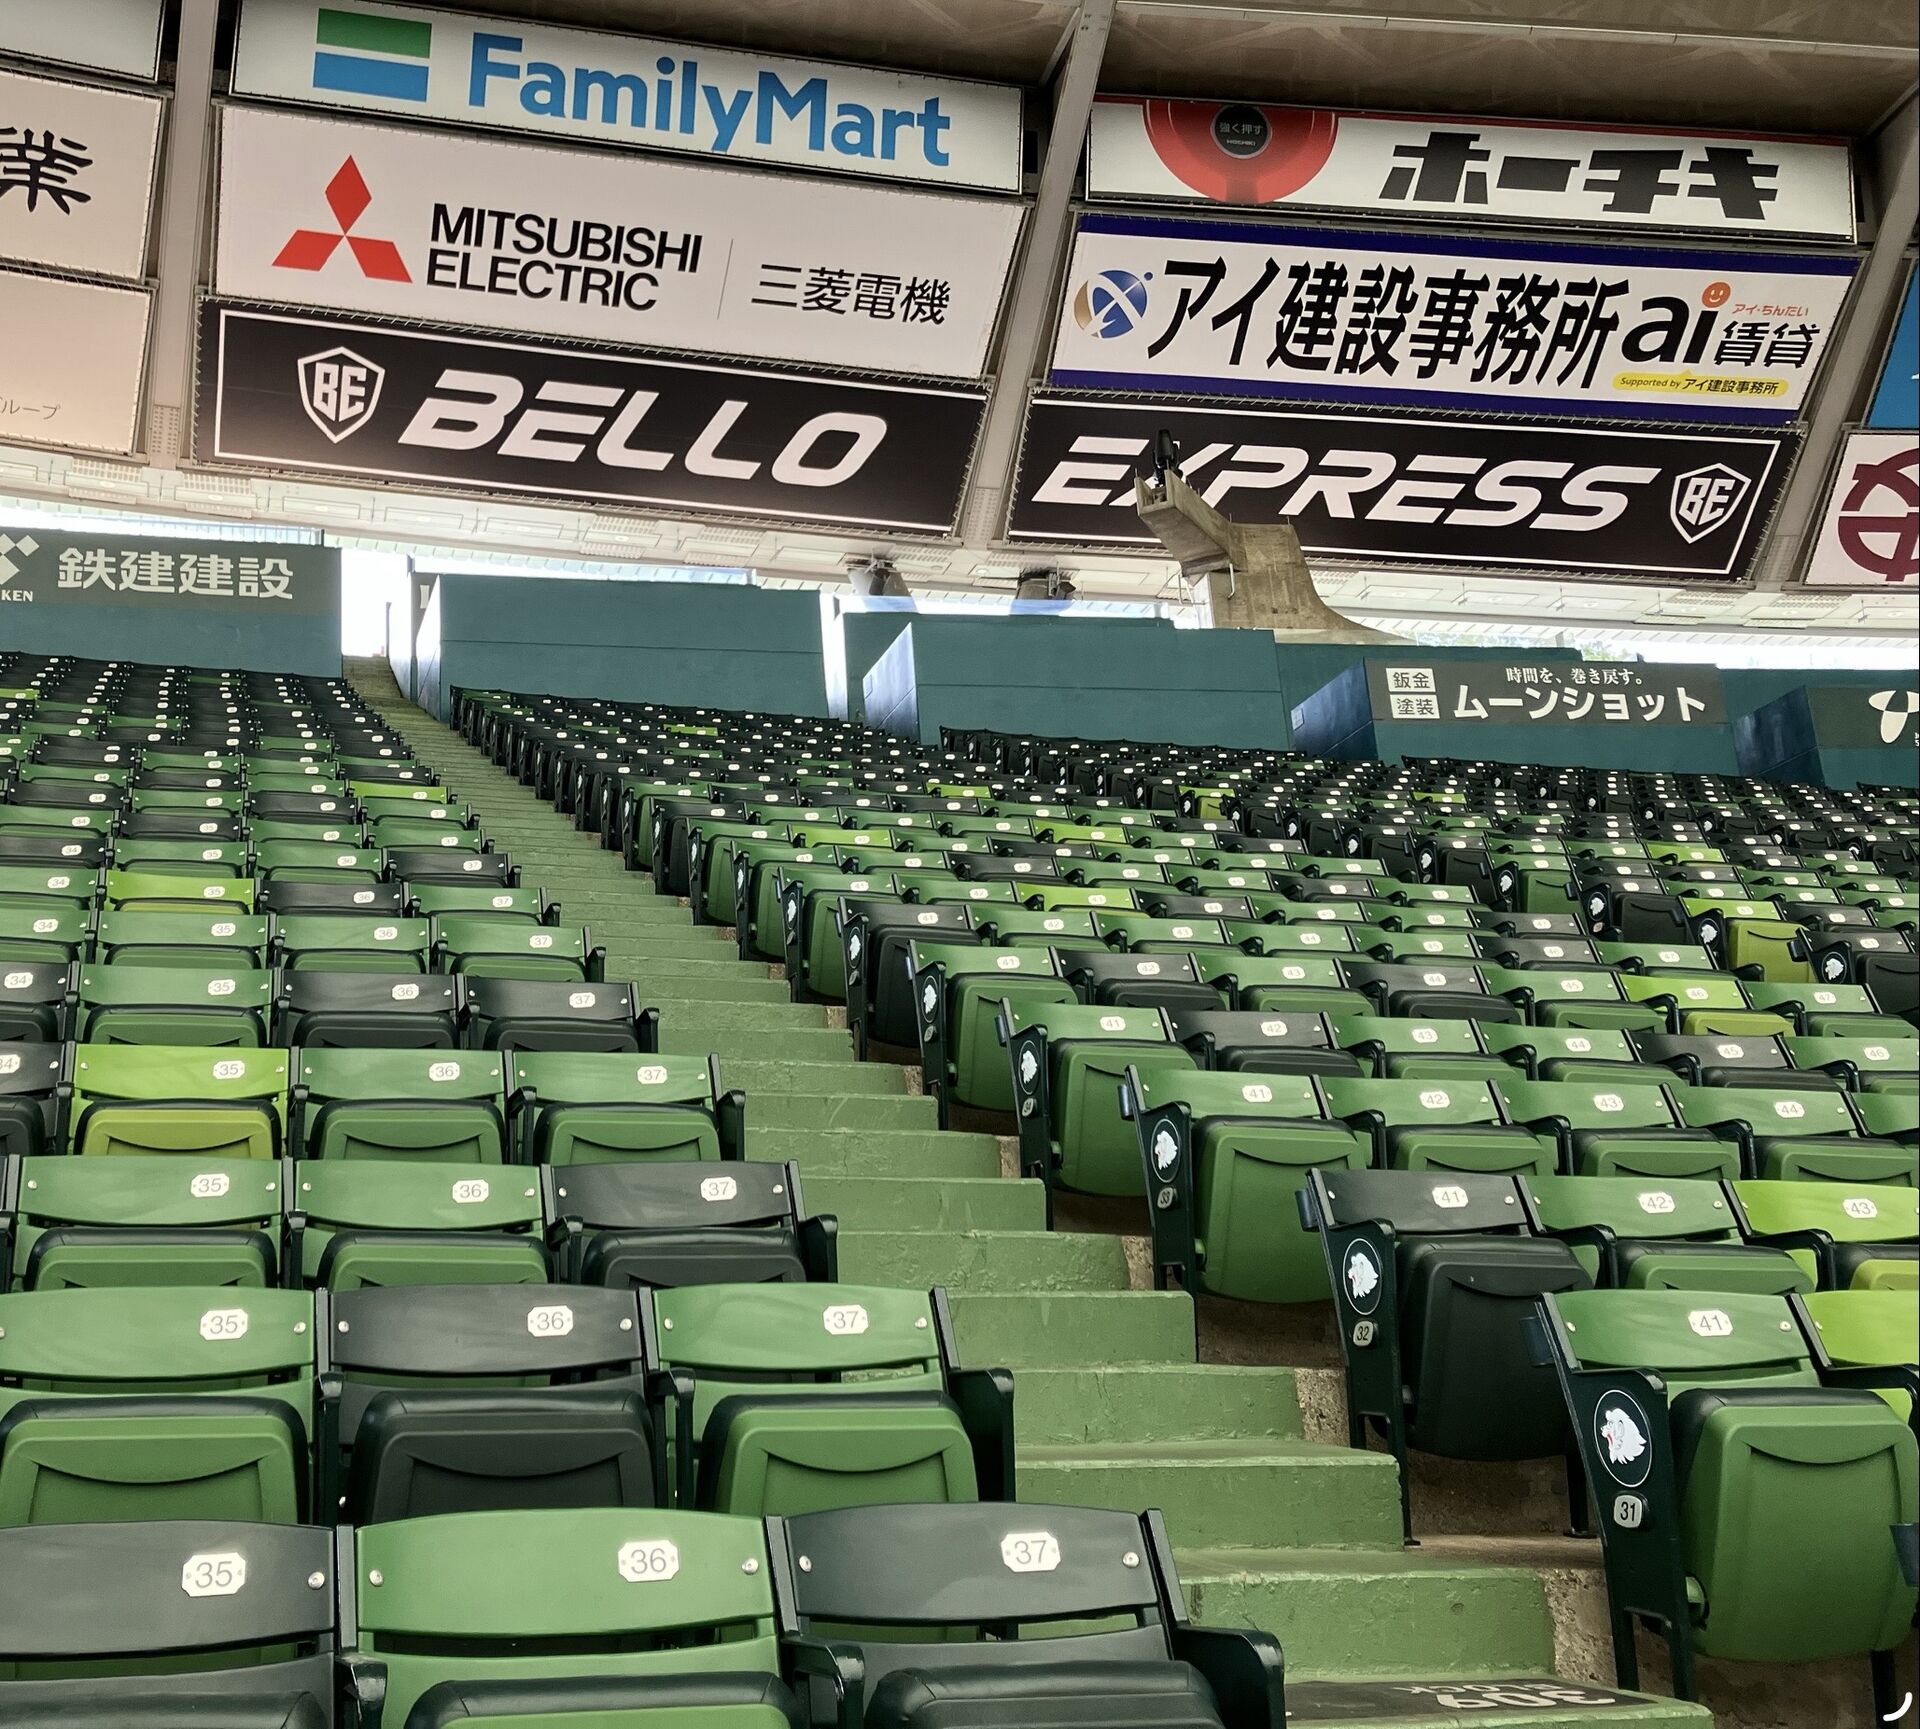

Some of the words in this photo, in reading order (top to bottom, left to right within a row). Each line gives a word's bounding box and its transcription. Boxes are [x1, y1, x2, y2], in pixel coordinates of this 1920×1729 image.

[468, 32, 951, 167] FamilyMart
[1219, 122, 1263, 136] 強く押す
[1379, 131, 1779, 221] ホーチキ
[430, 203, 703, 273] MITSUBISHI
[426, 248, 660, 312] ELECTRIC
[751, 262, 951, 325] 三菱電機
[1732, 303, 1809, 317] アイ・ちんたい
[1147, 256, 1629, 390] アイ建設事務所
[1714, 320, 1821, 368] 賃貸
[1620, 376, 1668, 388] Supported
[1669, 379, 1682, 390] by
[1682, 378, 1780, 396] アイ建設事務所
[398, 368, 888, 488] BELLO
[57, 547, 294, 600] 鉄建建設
[1, 589, 33, 602] KEN
[1392, 671, 1431, 690] 鈑金
[1506, 667, 1644, 686] 時間を、巻き戻す。
[1396, 697, 1435, 716] 塗装
[1454, 685, 1706, 722] ムーンショット
[208, 888, 221, 896] 35
[358, 893, 370, 901] 36
[497, 898, 509, 906] 37
[922, 914, 934, 922] 41
[38, 921, 53, 930] 34
[216, 925, 231, 934] 35
[1047, 920, 1061, 930] 42
[379, 929, 393, 938] 36
[534, 937, 548, 946] 37
[1002, 958, 1015, 967] 41
[1142, 964, 1155, 973] 42
[1287, 968, 1301, 977] 43
[10, 975, 26, 985] 34
[1429, 975, 1442, 983] 44
[213, 982, 230, 993] 35
[397, 986, 414, 997] 36
[1566, 981, 1580, 990] 45
[575, 995, 590, 1005] 37
[1691, 990, 1704, 998] 46
[1106, 1019, 1120, 1028] 41
[1267, 1023, 1282, 1033] 42
[1418, 1031, 1433, 1040] 43
[1571, 1040, 1585, 1049] 44
[1723, 1046, 1739, 1056] 45
[1870, 1049, 1885, 1058] 46
[219, 1064, 239, 1076] 35
[435, 1065, 454, 1077] 36
[644, 1069, 662, 1081] 37
[1249, 1089, 1265, 1098] 41
[1426, 1094, 1444, 1105] 42
[1600, 1097, 1618, 1108] 43
[1781, 1104, 1798, 1114] 44
[198, 1178, 221, 1193] 35
[460, 1184, 482, 1198] 36
[709, 1181, 729, 1196] 37
[1442, 1191, 1460, 1203] 41
[1647, 1196, 1668, 1209] 42
[1851, 1202, 1871, 1215] 43
[210, 1315, 238, 1334] 35
[537, 1312, 564, 1330] 36
[833, 1311, 858, 1329] 37
[1700, 1315, 1722, 1331] 41
[1356, 1325, 1370, 1342] 32
[1620, 1501, 1637, 1522] 31
[1014, 1540, 1047, 1565] 37
[631, 1548, 667, 1574] 36
[195, 1561, 232, 1588] 35
[1436, 1690, 1616, 1709] 309
